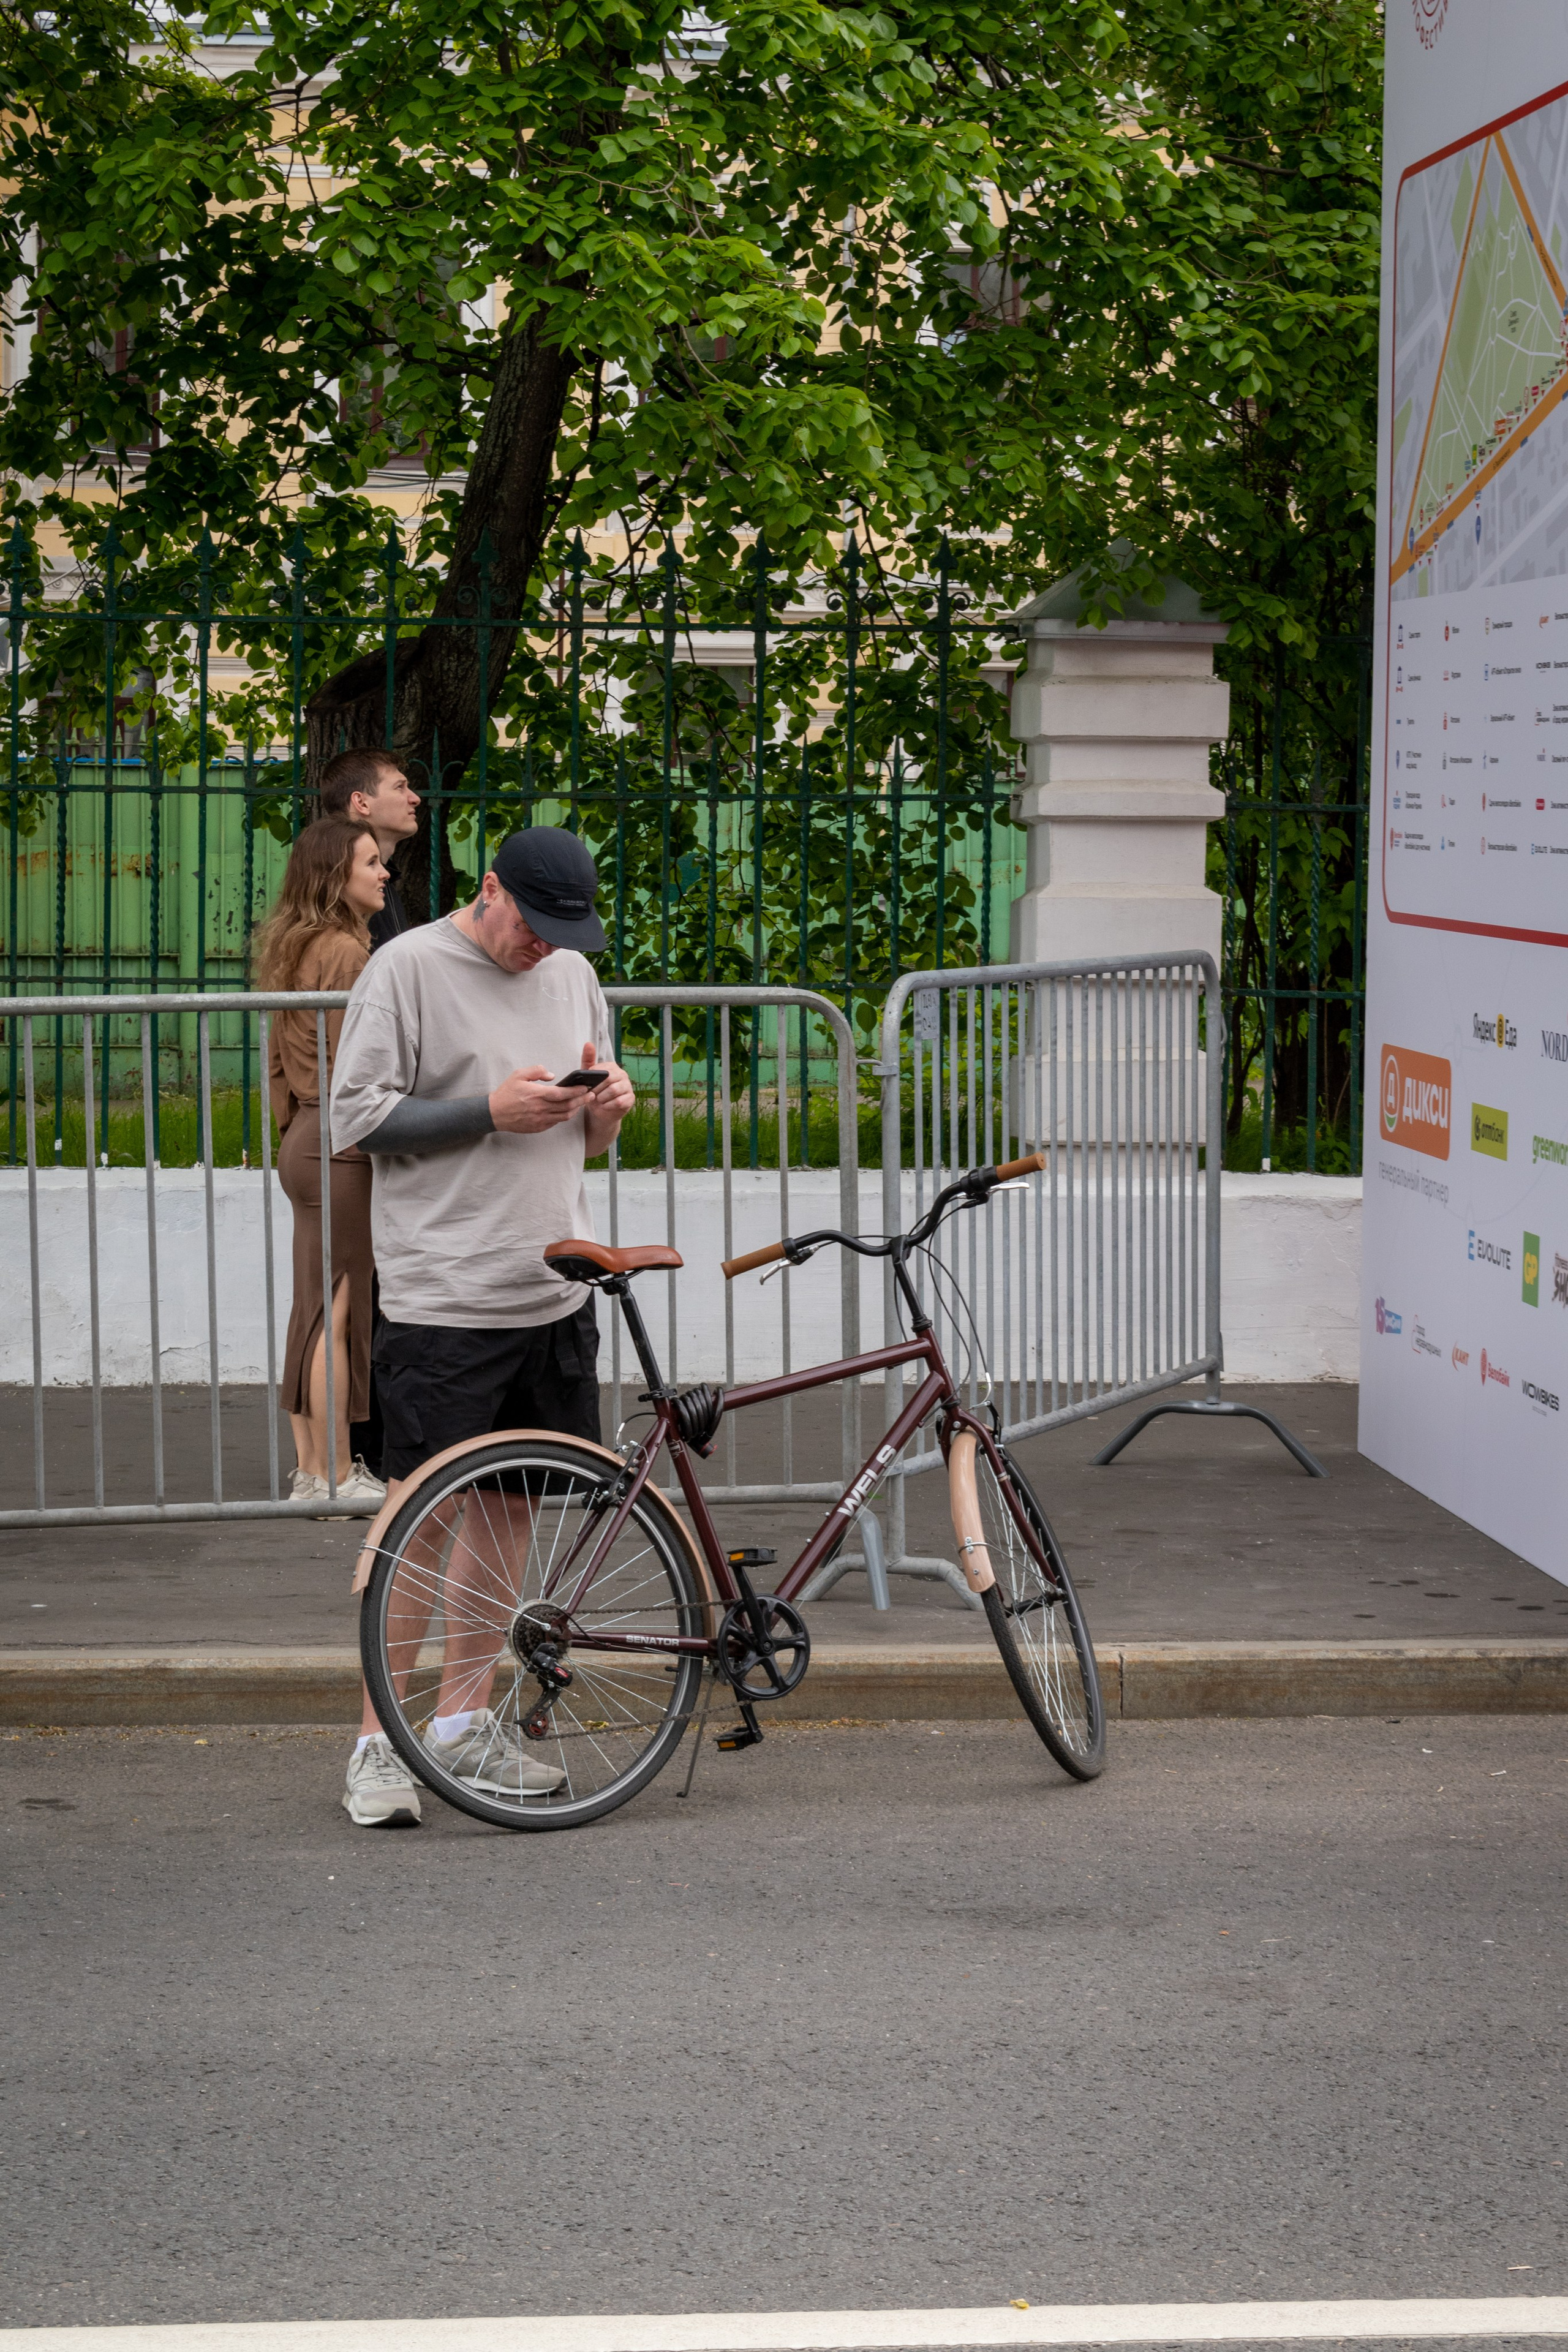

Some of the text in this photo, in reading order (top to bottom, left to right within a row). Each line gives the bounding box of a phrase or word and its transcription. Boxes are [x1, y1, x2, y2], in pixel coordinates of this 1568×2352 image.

[1473, 1012, 1517, 1050] Яндекс Еда
[1421, 1177, 1449, 1208] партнер
[1477, 1238, 1511, 1270] EVOLUTE
[1525, 1252, 1538, 1285] GP
[1488, 1362, 1510, 1387] Велобайк
[1521, 1379, 1559, 1411] WOWBIKES
[837, 1444, 897, 1517] WELS
[626, 1635, 679, 1646] SENATOR
